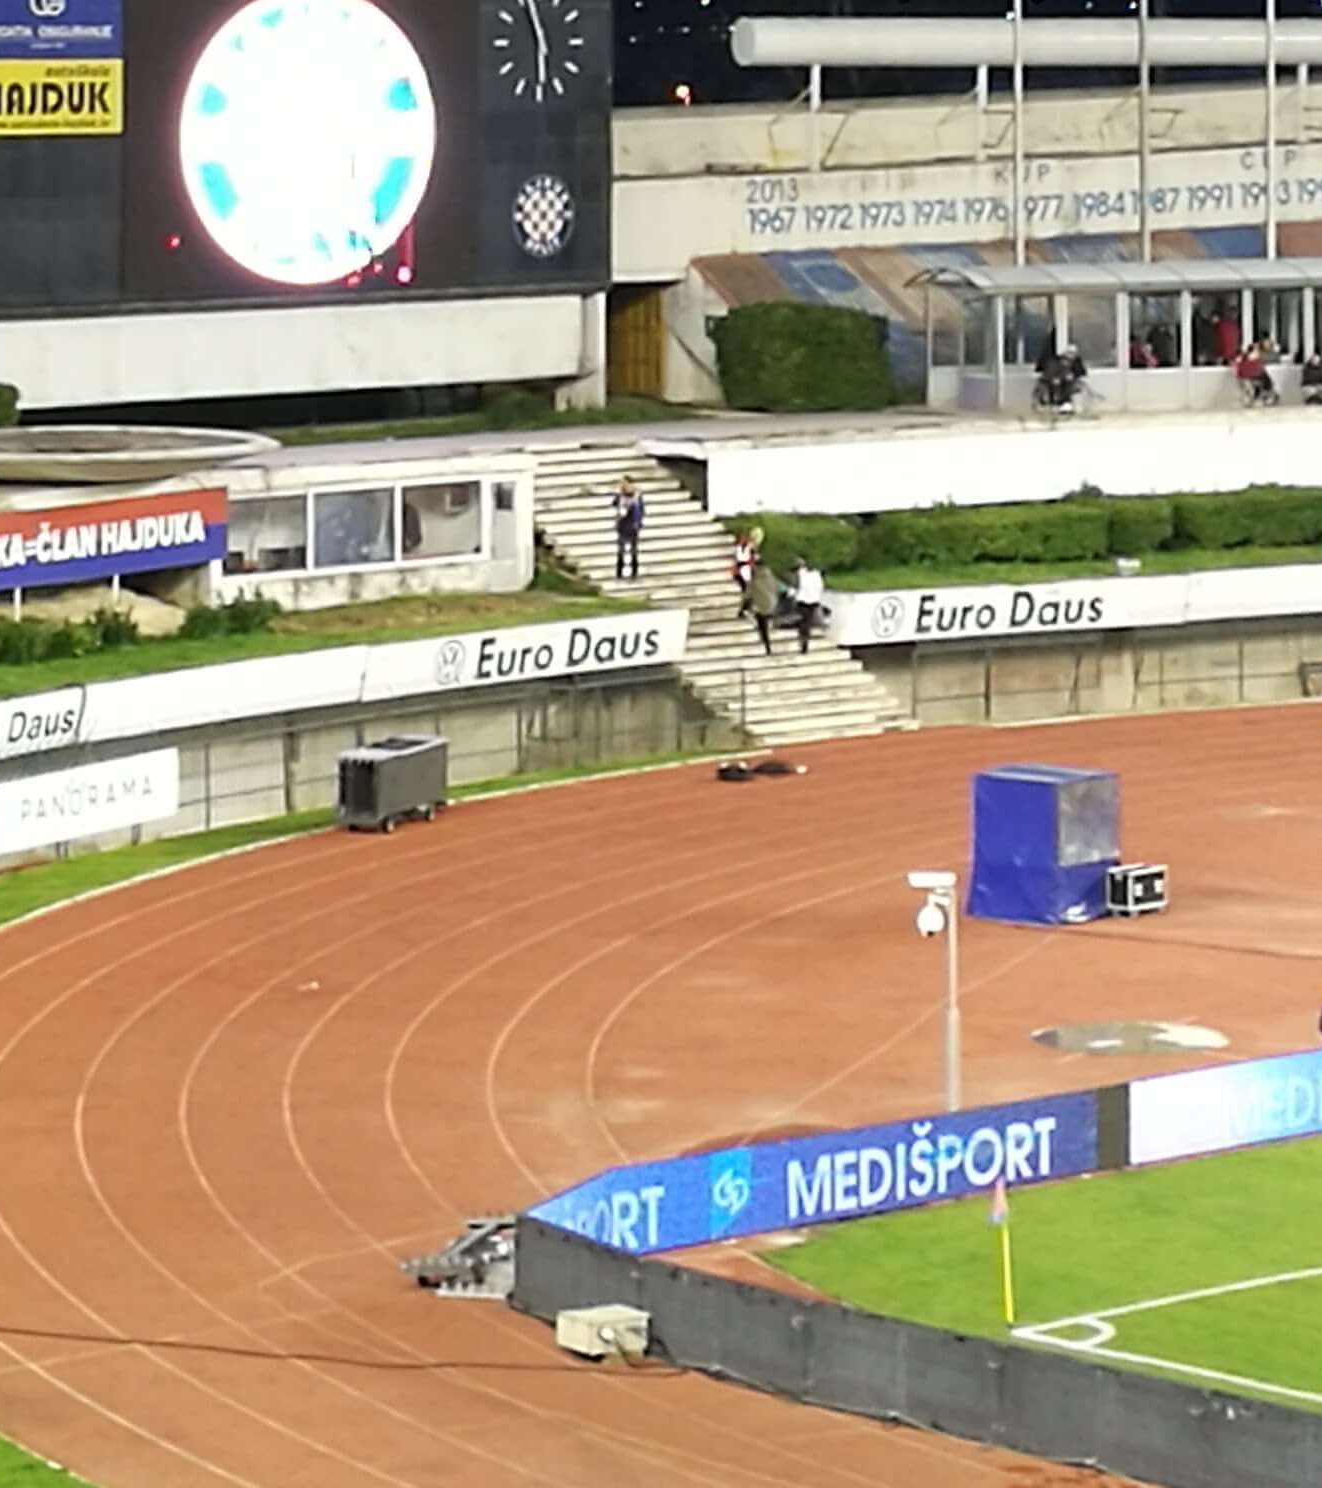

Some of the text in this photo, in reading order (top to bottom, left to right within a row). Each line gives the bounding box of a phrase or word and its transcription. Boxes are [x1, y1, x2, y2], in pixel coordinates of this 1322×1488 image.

[745, 177, 800, 204] 2013
[748, 207, 796, 235] 1967
[804, 204, 854, 231] 1972
[859, 201, 907, 228] 1973
[912, 199, 958, 226] 1974
[1024, 194, 1064, 222] 977
[1130, 187, 1179, 216] 187
[1187, 185, 1233, 212] 1991
[101, 510, 206, 555] HAJDUKA
[914, 588, 1104, 634] Euro Daus
[476, 626, 660, 681] Euro Daus
[7, 707, 76, 744] Daus
[787, 1118, 1057, 1220] MEDIŠPORT
